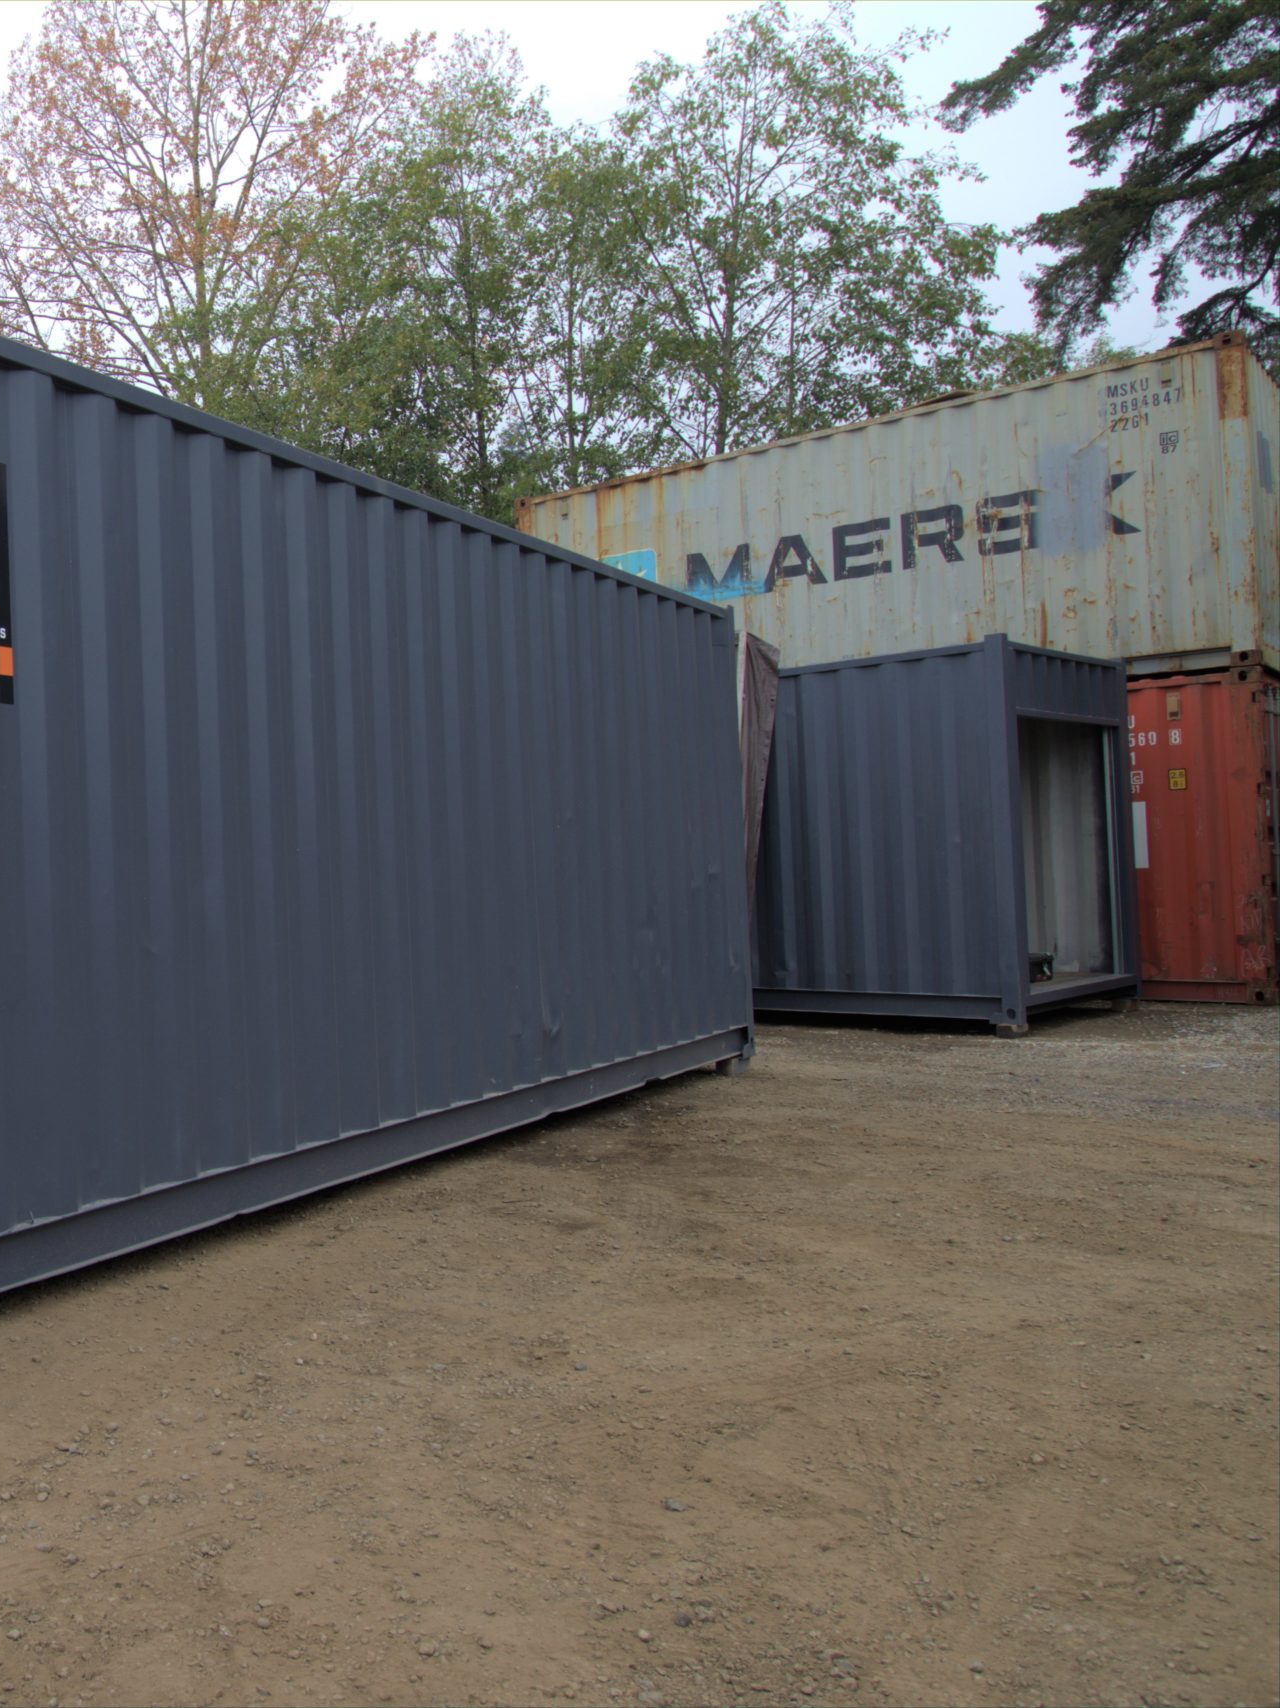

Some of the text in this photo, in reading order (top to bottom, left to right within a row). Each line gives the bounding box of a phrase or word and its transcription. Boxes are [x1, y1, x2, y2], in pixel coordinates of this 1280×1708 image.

[1107, 378, 1149, 399] MSKU
[1109, 387, 1181, 416] 3694847
[1110, 413, 1149, 432] 22G1
[1161, 445, 1177, 455] 87
[1171, 730, 1181, 745] 8
